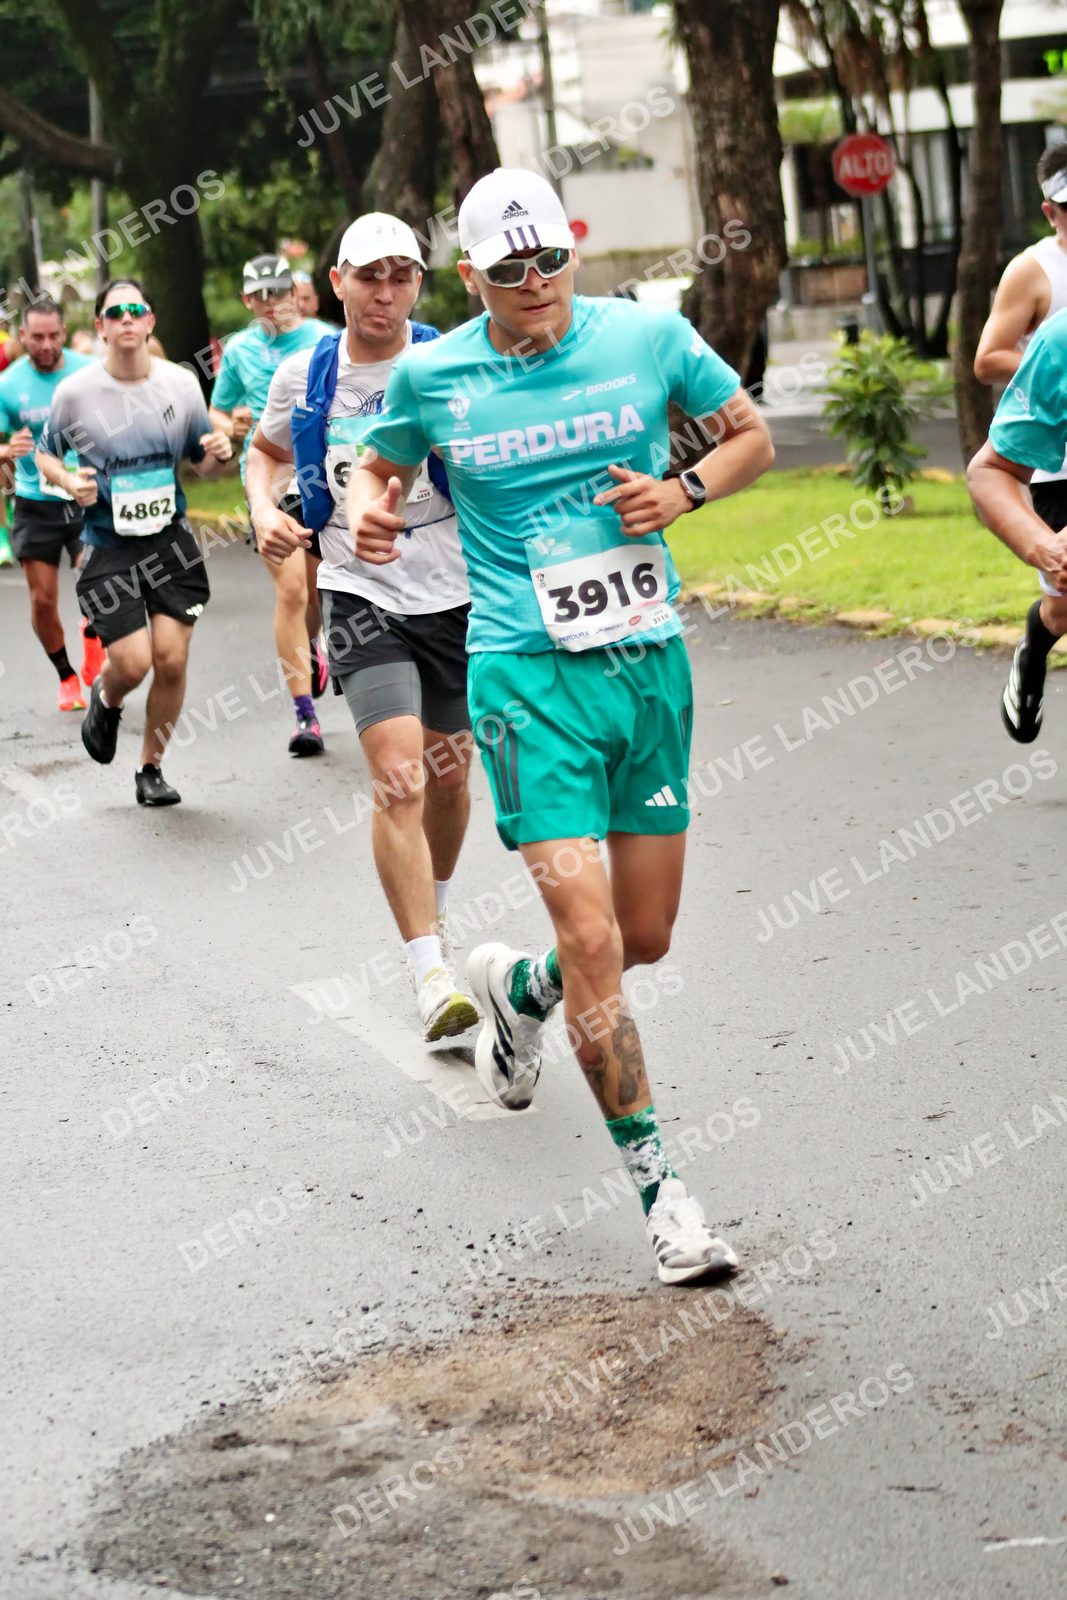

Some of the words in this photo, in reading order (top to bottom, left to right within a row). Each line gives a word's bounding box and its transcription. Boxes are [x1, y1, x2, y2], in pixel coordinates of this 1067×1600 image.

[839, 150, 889, 179] ALTO
[502, 210, 528, 220] adidas
[585, 373, 636, 397] BROOKS
[448, 404, 645, 466] PERDURA
[120, 498, 172, 520] 4862
[548, 562, 658, 624] 3916
[558, 631, 590, 642] PERDURA
